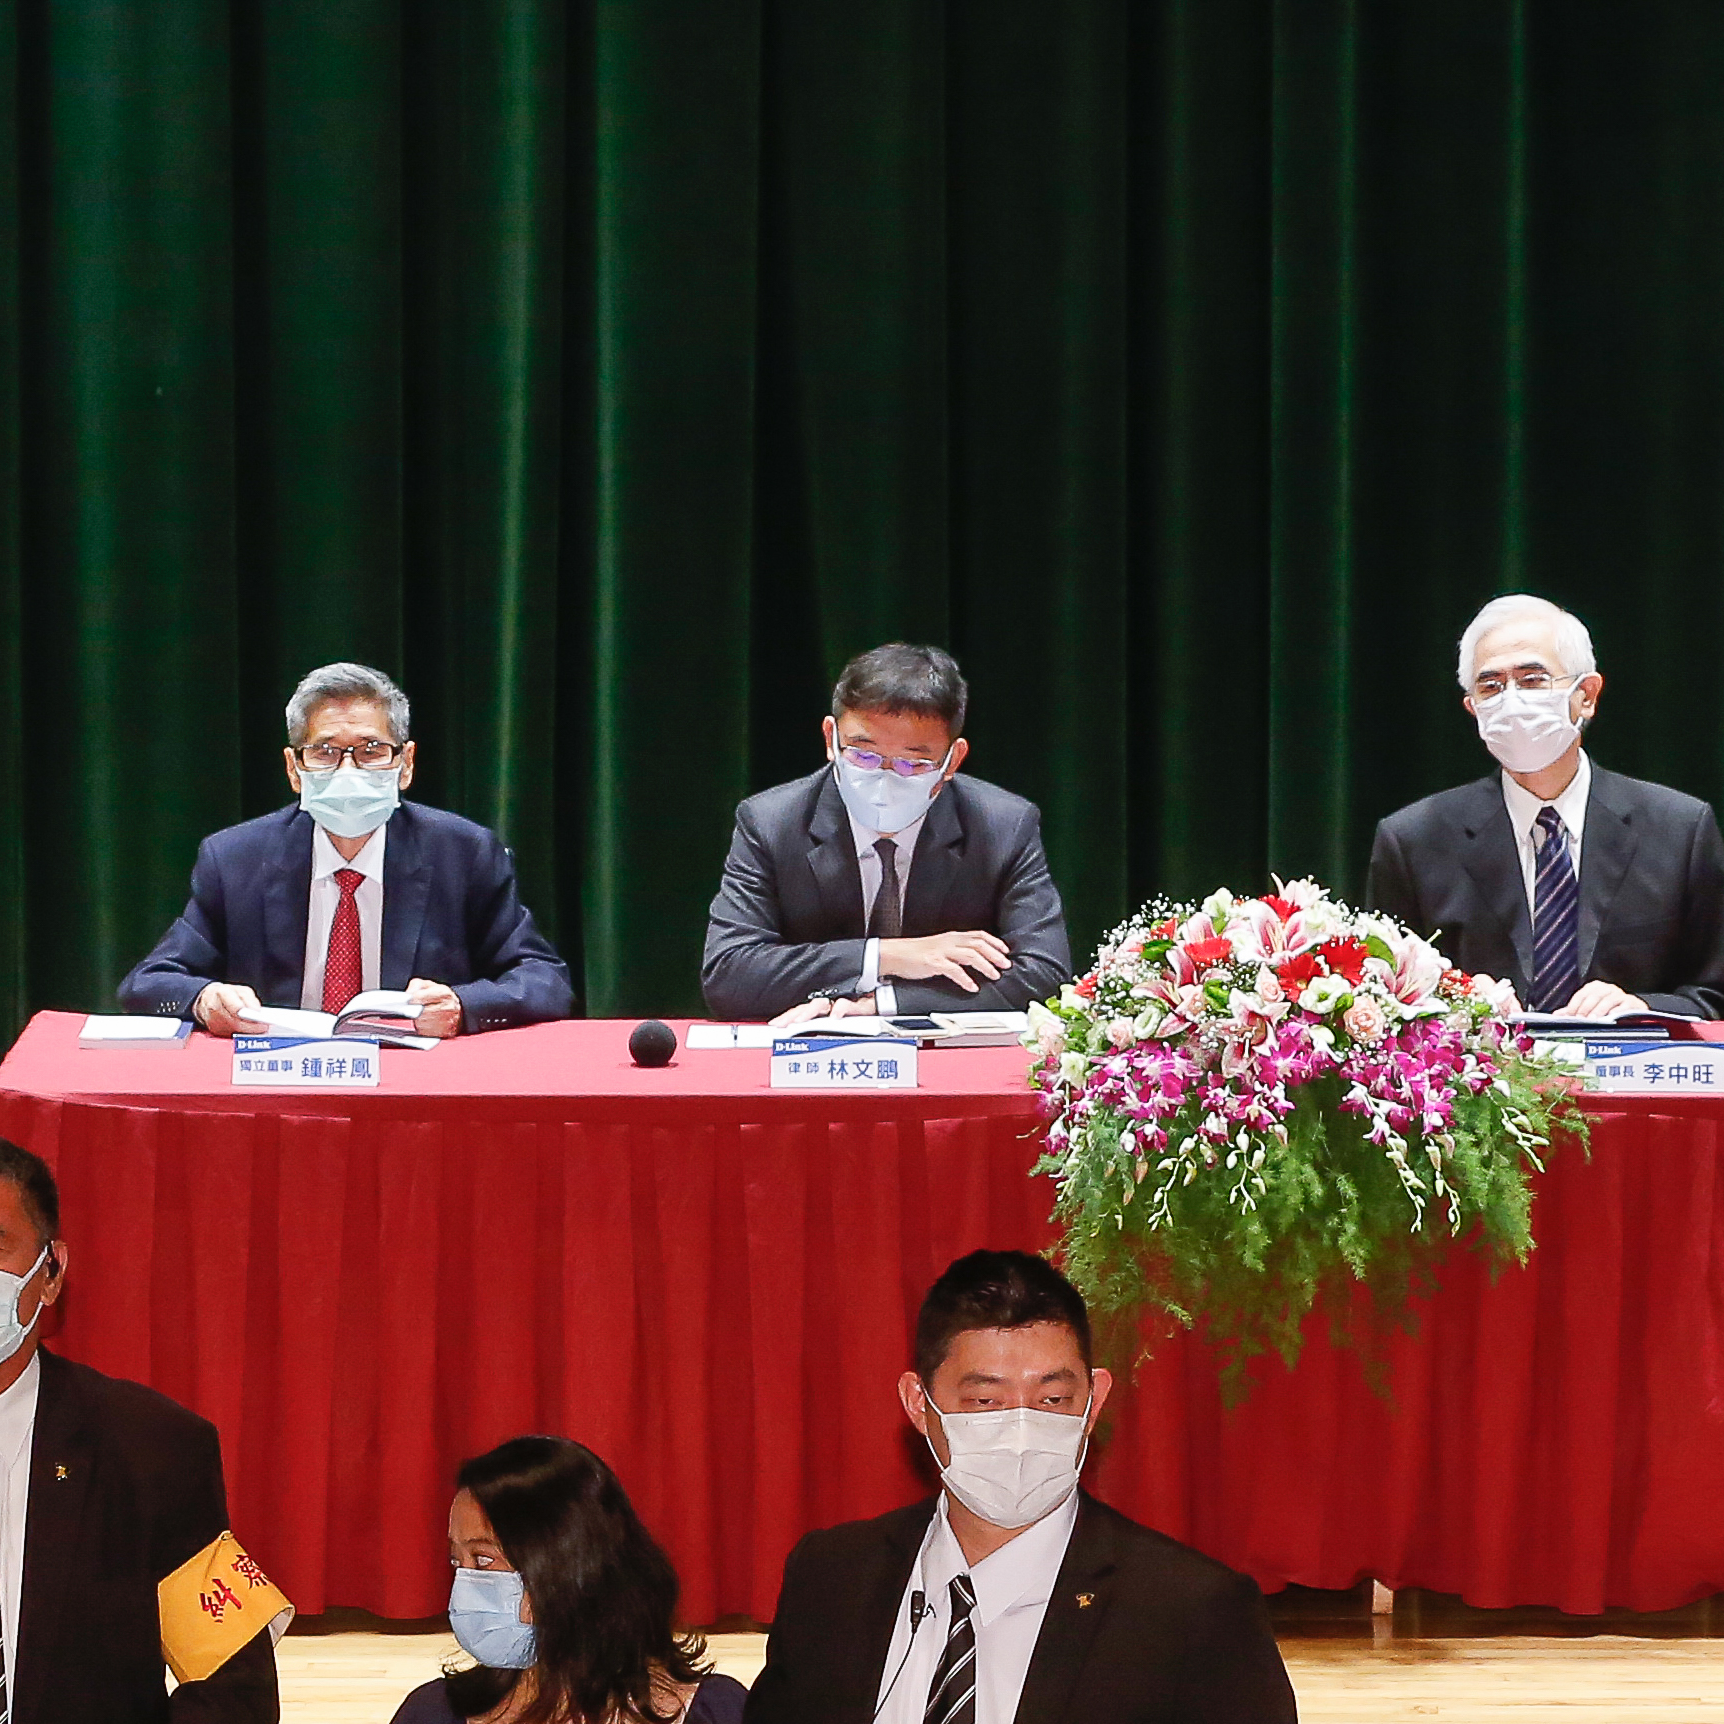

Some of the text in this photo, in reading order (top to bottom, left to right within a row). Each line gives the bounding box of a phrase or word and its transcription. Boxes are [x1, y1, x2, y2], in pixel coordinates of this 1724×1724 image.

[237, 1040, 272, 1049] D-Link
[775, 1042, 809, 1051] D-Link
[1588, 1045, 1622, 1055] D-Link
[788, 1061, 820, 1075] 律師
[1643, 1062, 1715, 1085] 李中旺
